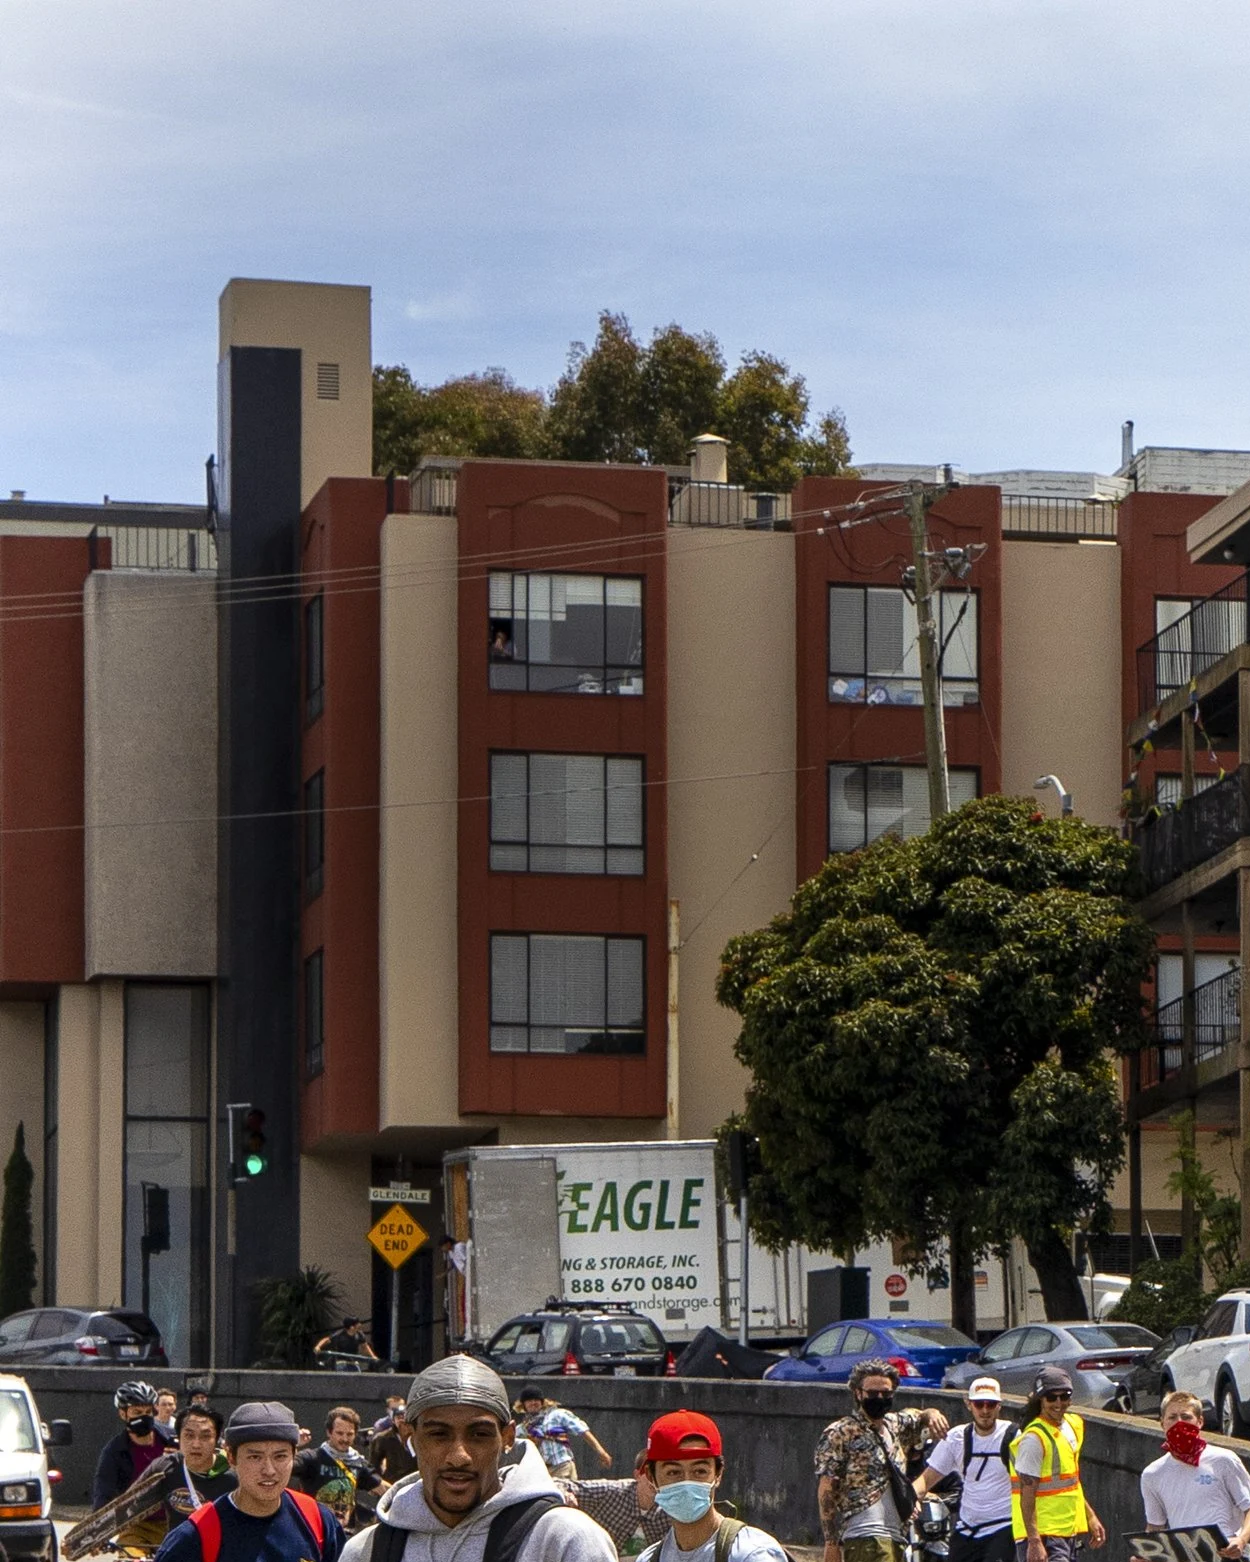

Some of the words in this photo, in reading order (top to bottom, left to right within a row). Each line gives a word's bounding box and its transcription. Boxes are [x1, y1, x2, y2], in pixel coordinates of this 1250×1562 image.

[372, 1190, 428, 1201] GLENDALE
[566, 1178, 705, 1234] EAGLE
[380, 1223, 414, 1236] DEAD
[384, 1239, 409, 1252] END
[562, 1258, 583, 1272] NG
[585, 1257, 597, 1270] &
[600, 1255, 667, 1270] STORAGE,
[671, 1254, 700, 1268] INC.
[571, 1279, 605, 1294] 888
[611, 1277, 646, 1292] 670
[651, 1275, 698, 1291] 0840
